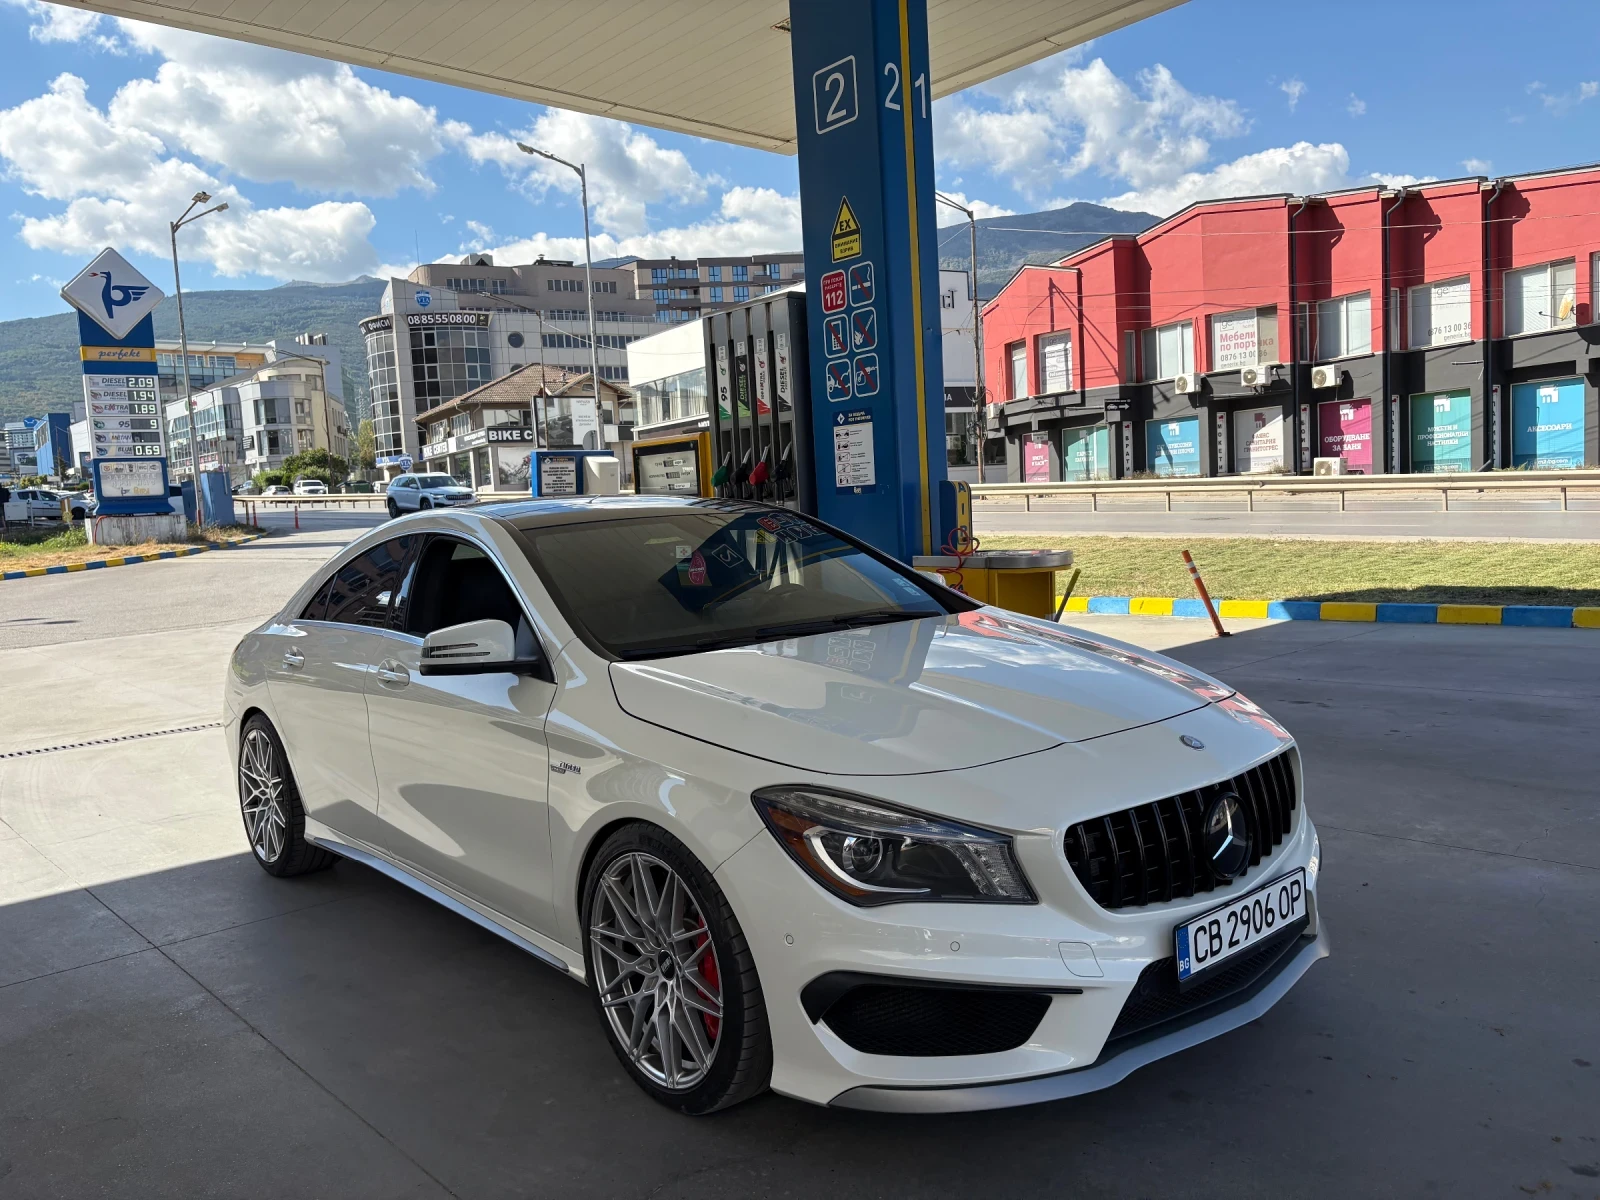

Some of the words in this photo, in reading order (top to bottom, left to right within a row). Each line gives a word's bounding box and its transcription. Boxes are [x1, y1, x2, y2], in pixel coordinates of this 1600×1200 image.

[884, 62, 901, 111] 2
[825, 72, 847, 123] 2
[914, 73, 927, 119] 1
[839, 218, 852, 232] EX
[825, 290, 844, 307] 112
[1444, 325, 1452, 334] 13
[1453, 323, 1462, 332] 00
[1219, 331, 1256, 343] Мебели
[1220, 343, 1232, 352] по
[98, 349, 141, 360] perfekt
[1220, 353, 1237, 362] 0876
[1239, 351, 1247, 360] 13
[128, 377, 154, 388] 2.09
[133, 391, 155, 401] 1.94
[720, 386, 728, 402] 95
[134, 404, 156, 414] 1.89
[118, 420, 131, 428] 95
[150, 419, 158, 429] 9
[1526, 422, 1573, 433] АКСЕСОАРИ
[488, 430, 521, 441] BIKE
[1324, 432, 1371, 443] ОБОРУДВАНЕ
[135, 445, 160, 456] 0.69
[1332, 444, 1342, 452] ЗА
[1342, 442, 1362, 451] ВАНЯ
[1193, 918, 1223, 964] CB
[1226, 892, 1276, 949] 2906
[1278, 878, 1302, 921] OP
[1178, 957, 1191, 972] BG
